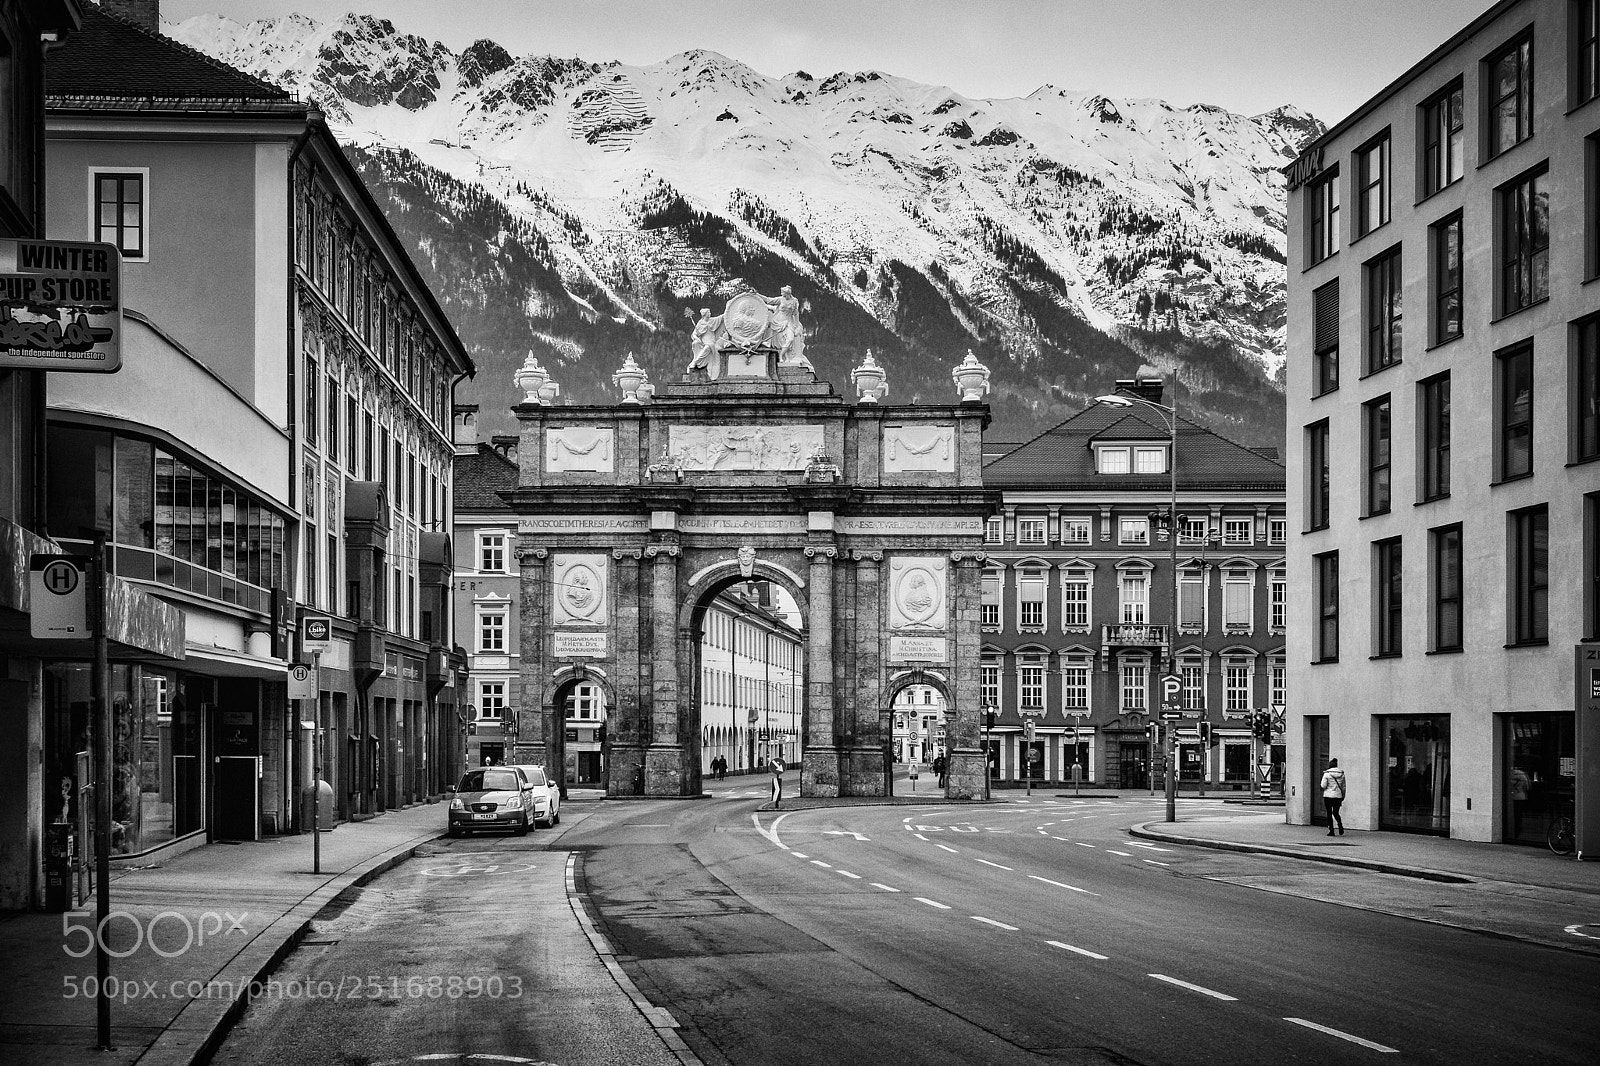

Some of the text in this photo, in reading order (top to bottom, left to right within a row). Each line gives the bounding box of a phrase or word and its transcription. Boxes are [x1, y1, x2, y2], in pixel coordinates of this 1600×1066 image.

[21, 244, 108, 273] WINTER
[42, 278, 112, 301] STORE
[8, 348, 105, 360] the independent sportstore
[52, 568, 70, 589] H
[296, 669, 304, 679] H
[1164, 681, 1180, 702] P
